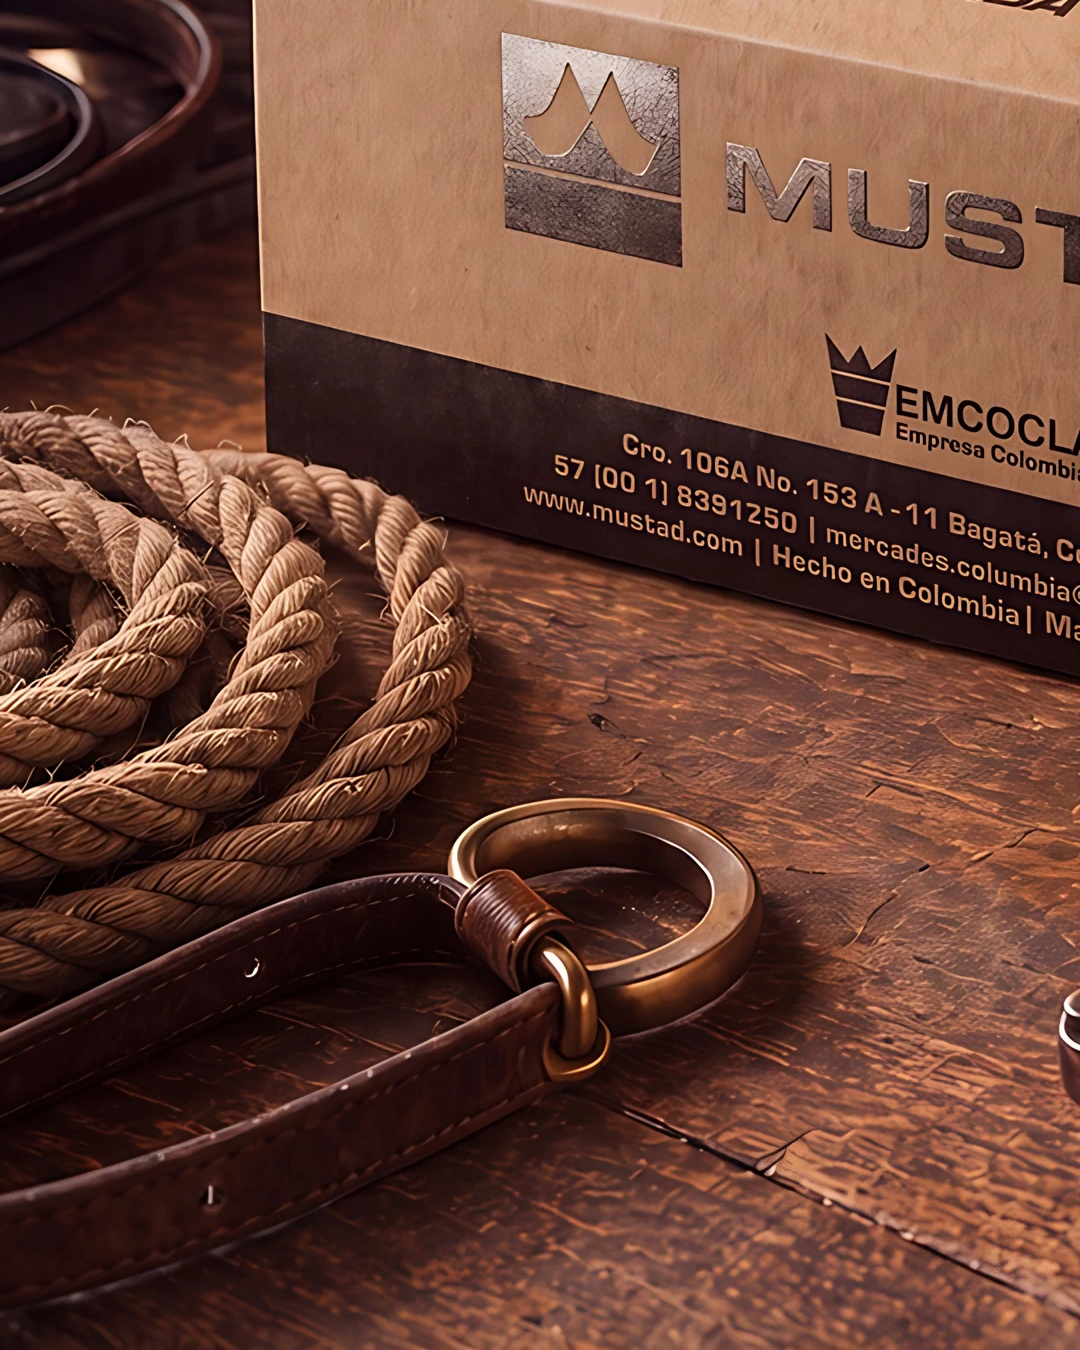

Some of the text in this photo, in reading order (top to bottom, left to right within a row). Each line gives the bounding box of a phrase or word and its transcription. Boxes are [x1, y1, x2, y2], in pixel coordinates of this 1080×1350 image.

[622, 433, 673, 465] Cro.
[680, 448, 750, 485] 106A
[756, 465, 799, 496] No.
[806, 478, 858, 510] 153
[896, 422, 986, 459] Empresa
[554, 454, 586, 480] 57
[676, 484, 798, 535] 8391250
[523, 486, 743, 557] www.mustad.com
[772, 543, 853, 585] Hecho
[860, 569, 891, 595] en
